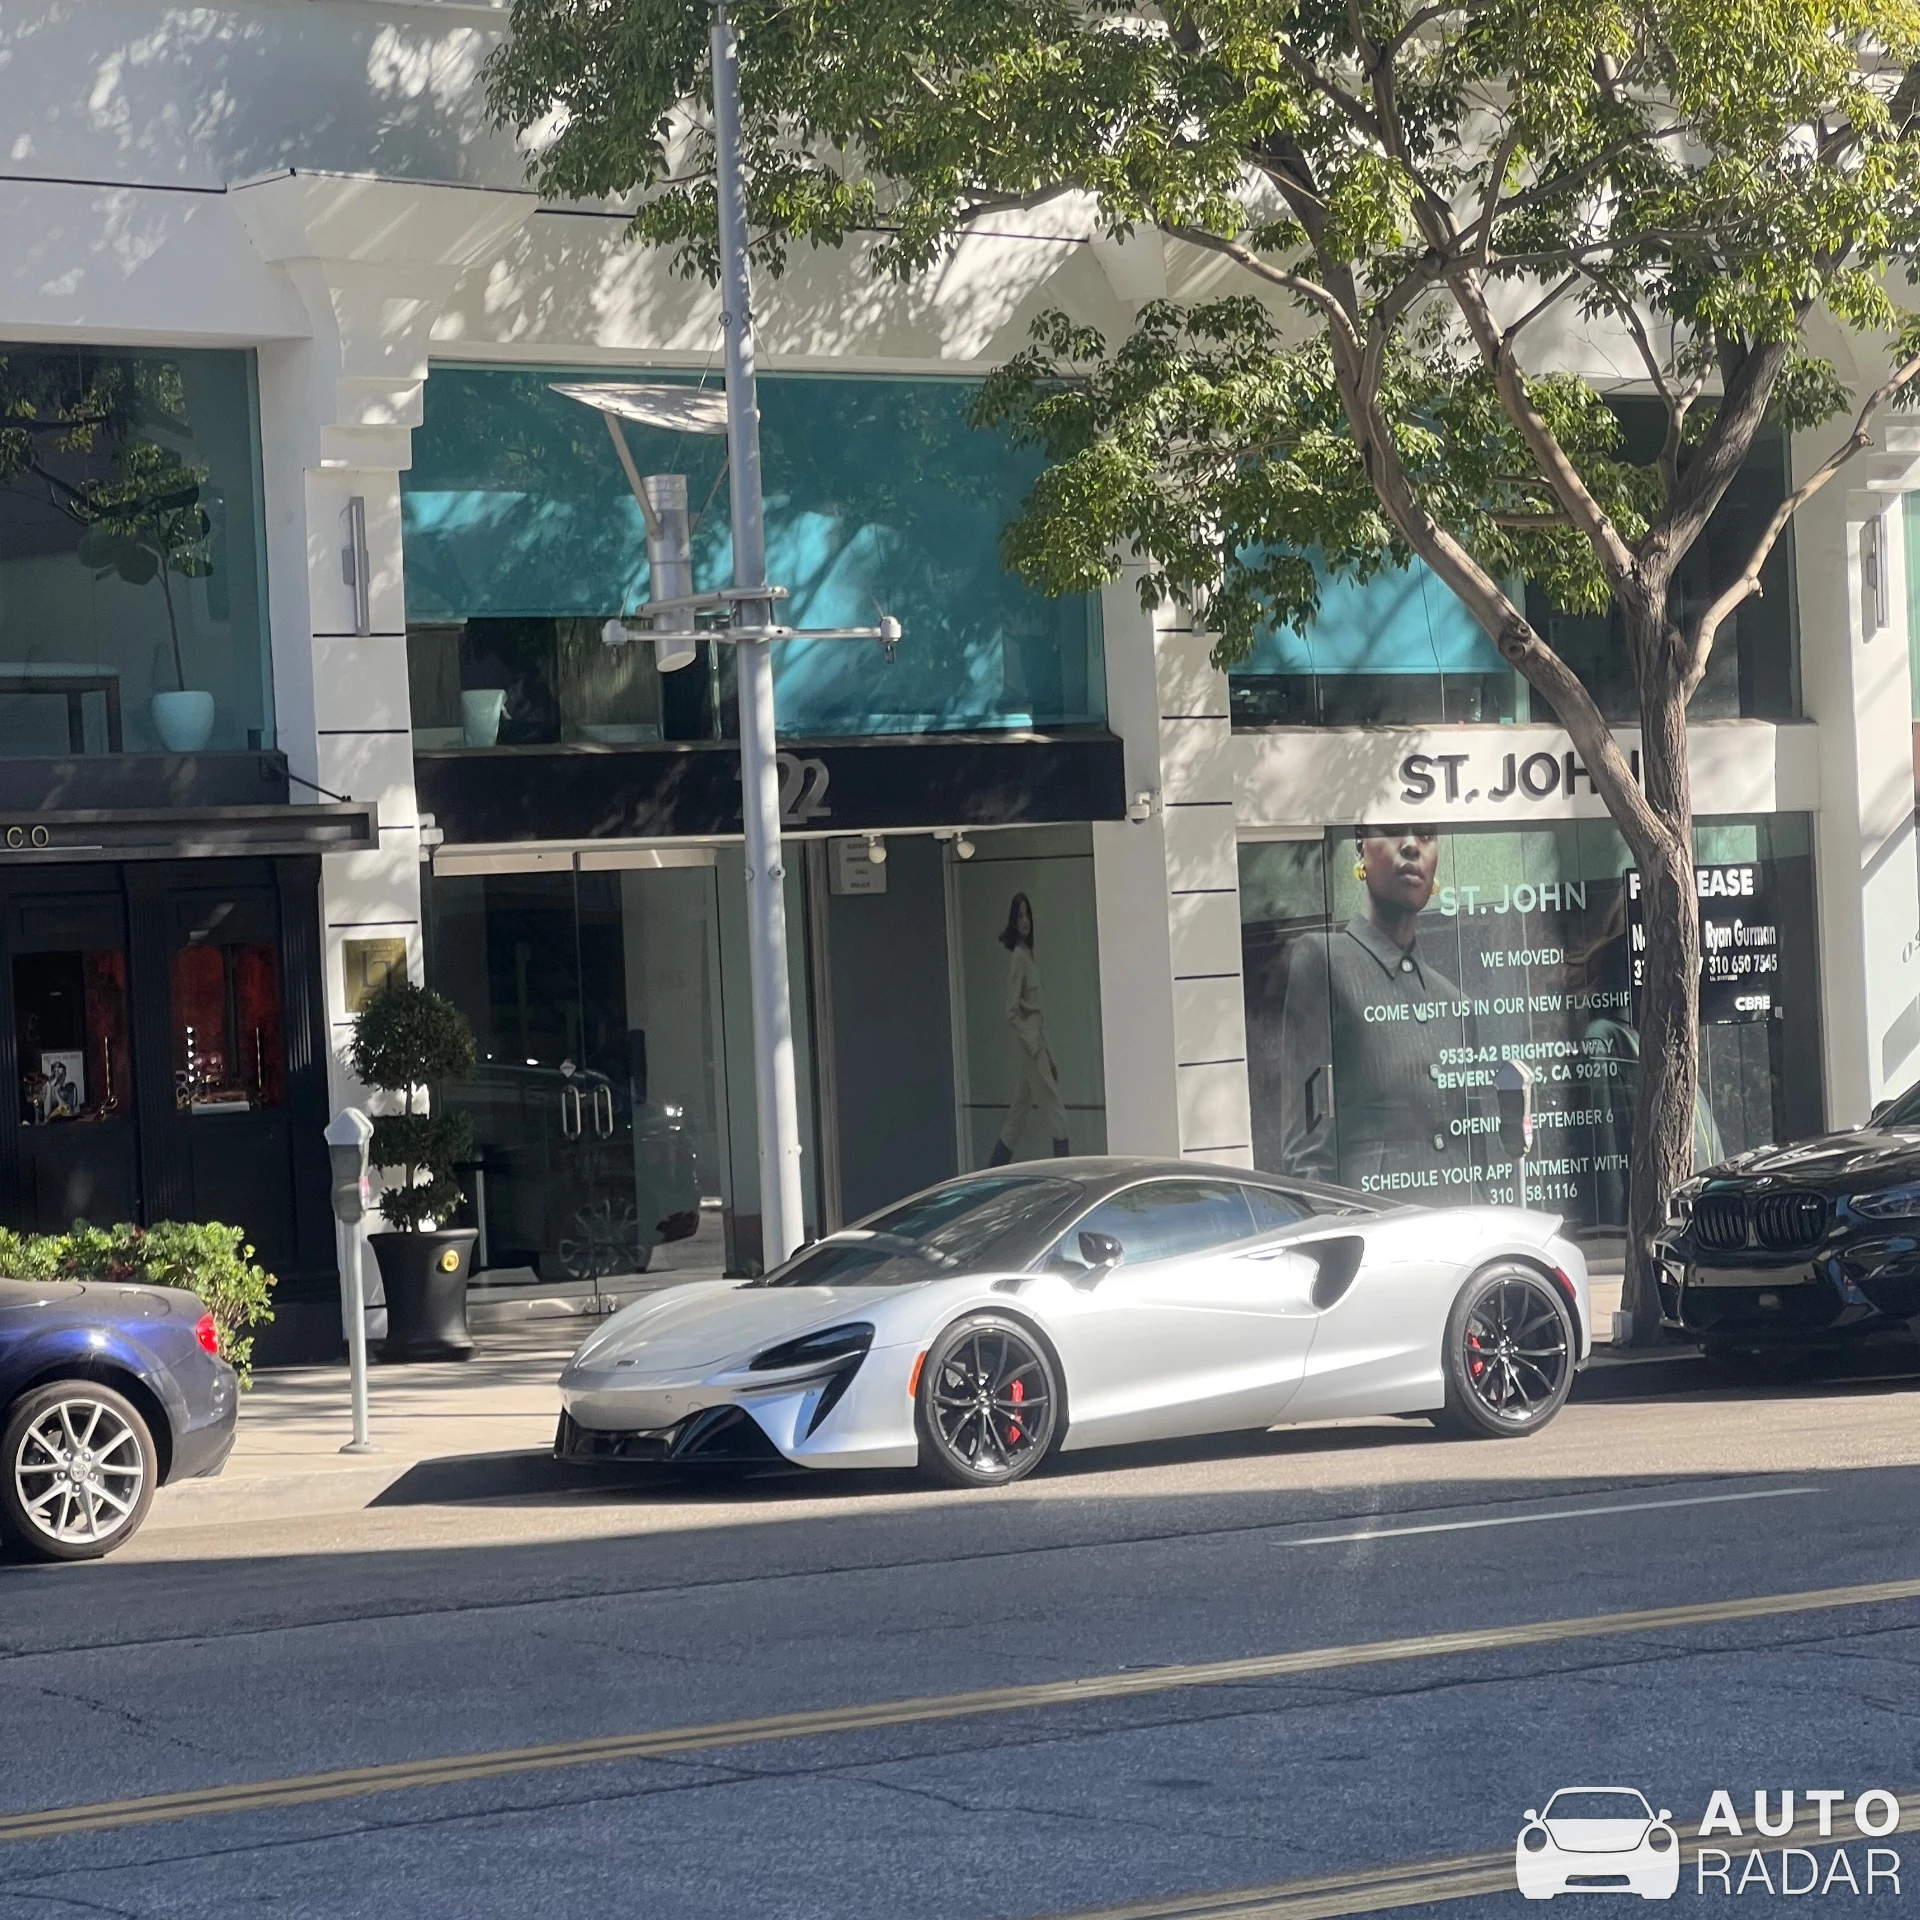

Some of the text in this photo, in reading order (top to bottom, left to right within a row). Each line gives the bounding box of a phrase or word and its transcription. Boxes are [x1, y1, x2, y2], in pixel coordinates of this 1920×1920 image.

[1403, 753, 1480, 799] ST.
[7, 825, 49, 849] CO
[1697, 869, 1754, 897] EASE
[1439, 881, 1586, 916] ST. JOHN
[1705, 918, 1776, 955] Ryan Gurman
[1481, 948, 1564, 968] WE MOVED!
[1709, 955, 1728, 975] 310
[1731, 954, 1750, 973] 650
[1754, 953, 1777, 973] 7545
[1364, 1004, 1409, 1023] COME
[1413, 1002, 1447, 1019] VISIT
[1451, 1000, 1470, 1017] US
[1474, 999, 1489, 1015] IN
[1493, 997, 1524, 1014] OUR
[1528, 995, 1561, 1011] NEW
[1735, 995, 1771, 1011] CBRE
[1439, 1038, 1613, 1065] 9533-A2 BRIGHTON WAY
[1551, 1064, 1572, 1081] CA
[1576, 1060, 1618, 1079] 90210
[1530, 1109, 1602, 1130] EPTEMBER
[1606, 1108, 1614, 1123] 6
[1361, 1154, 1629, 1193] SCHEDULE YOUR APPINTMENT WITH
